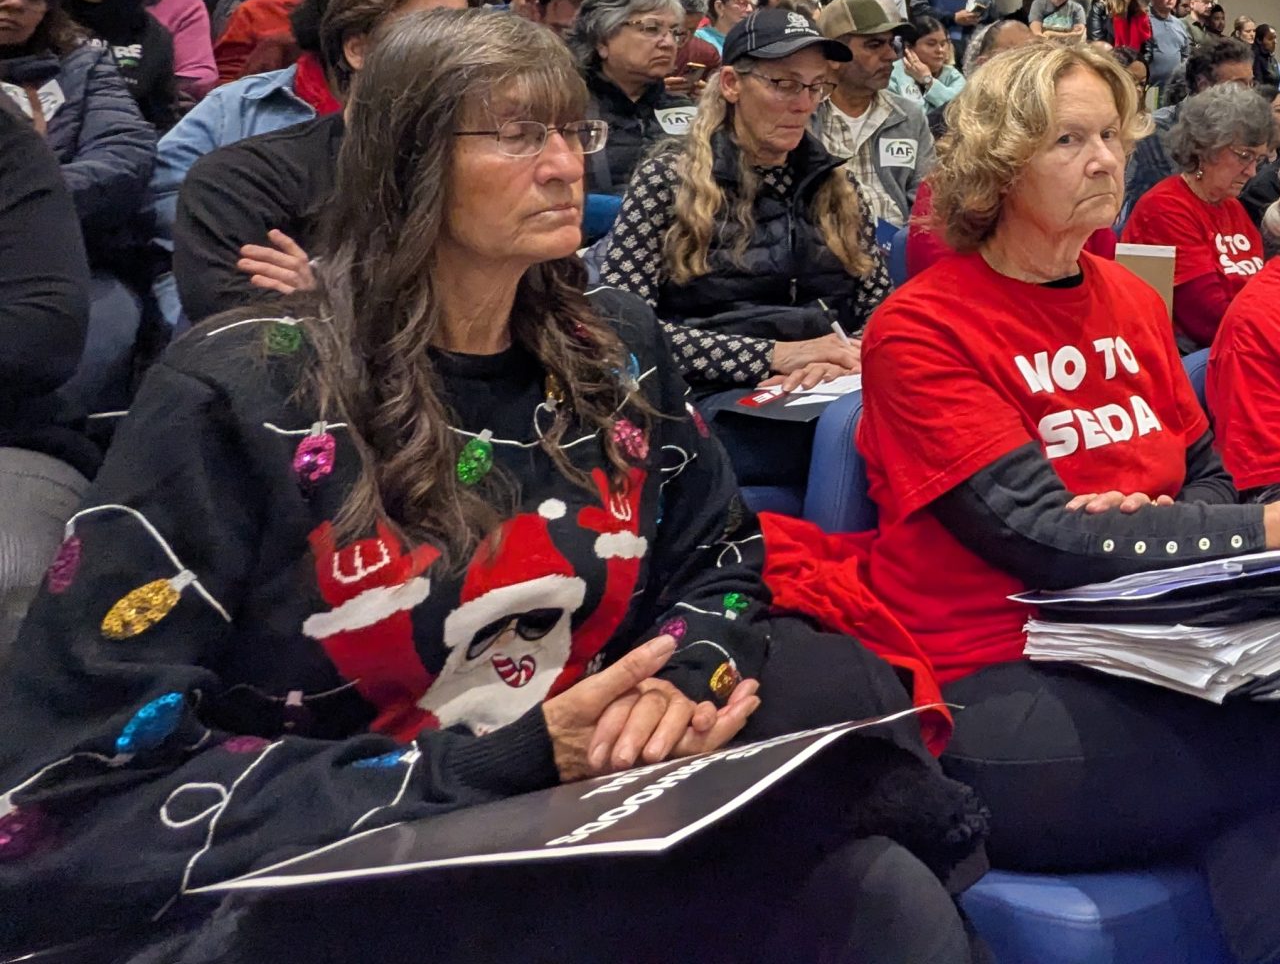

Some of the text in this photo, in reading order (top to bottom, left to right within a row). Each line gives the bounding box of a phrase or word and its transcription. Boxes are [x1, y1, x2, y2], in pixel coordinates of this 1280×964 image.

[890, 147, 913, 156] IAF
[1224, 233, 1251, 255] TO
[1014, 336, 1140, 394] NO TO
[1038, 395, 1163, 459] SEDA
